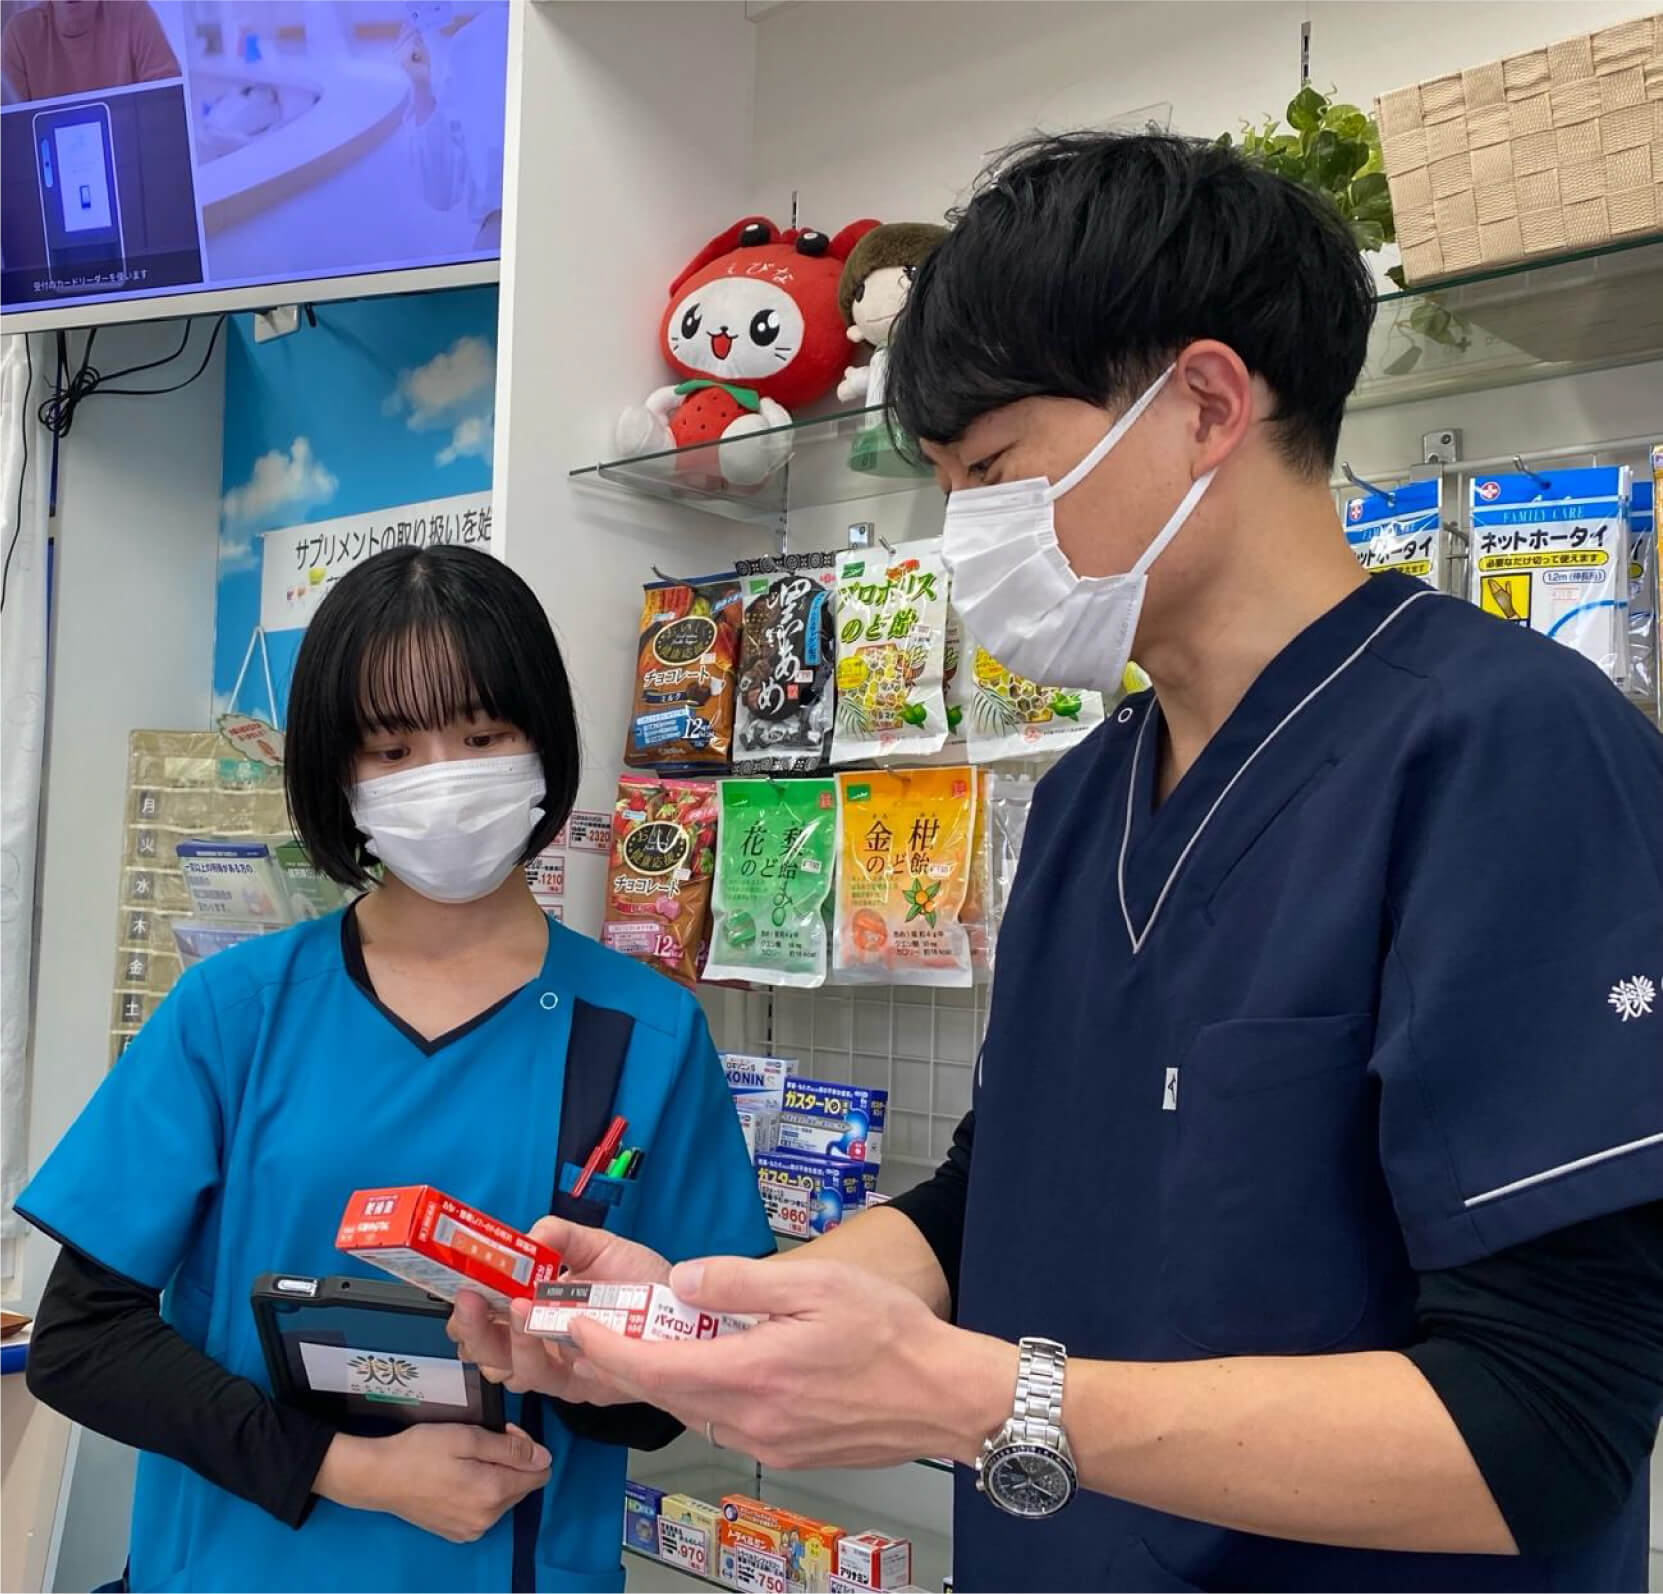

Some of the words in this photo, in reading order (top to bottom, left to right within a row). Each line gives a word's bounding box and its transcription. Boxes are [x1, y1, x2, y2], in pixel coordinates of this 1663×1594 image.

[1504, 509, 1546, 523] FAMILY
[1552, 505, 1585, 519] CARE
[1480, 525, 1608, 553] ネットホータイ
[1486, 553, 1598, 569] 必要なだけ切って使えます
[841, 608, 919, 644] のど飴
[644, 666, 711, 687] チョコレート
[142, 797, 155, 814] 月
[864, 818, 940, 852] 金柑
[141, 836, 154, 853] 火
[866, 852, 929, 875] のど飴
[135, 879, 149, 894] 水
[614, 876, 681, 899] チョコレート
[133, 918, 147, 934] 木
[128, 958, 144, 975] 金
[125, 1002, 139, 1017] 土
[781, 1207, 807, 1224] 960
[655, 1313, 696, 1335] パイロン
[697, 1312, 719, 1339] PI
[680, 1544, 705, 1563] 970
[760, 1574, 783, 1593] 750
